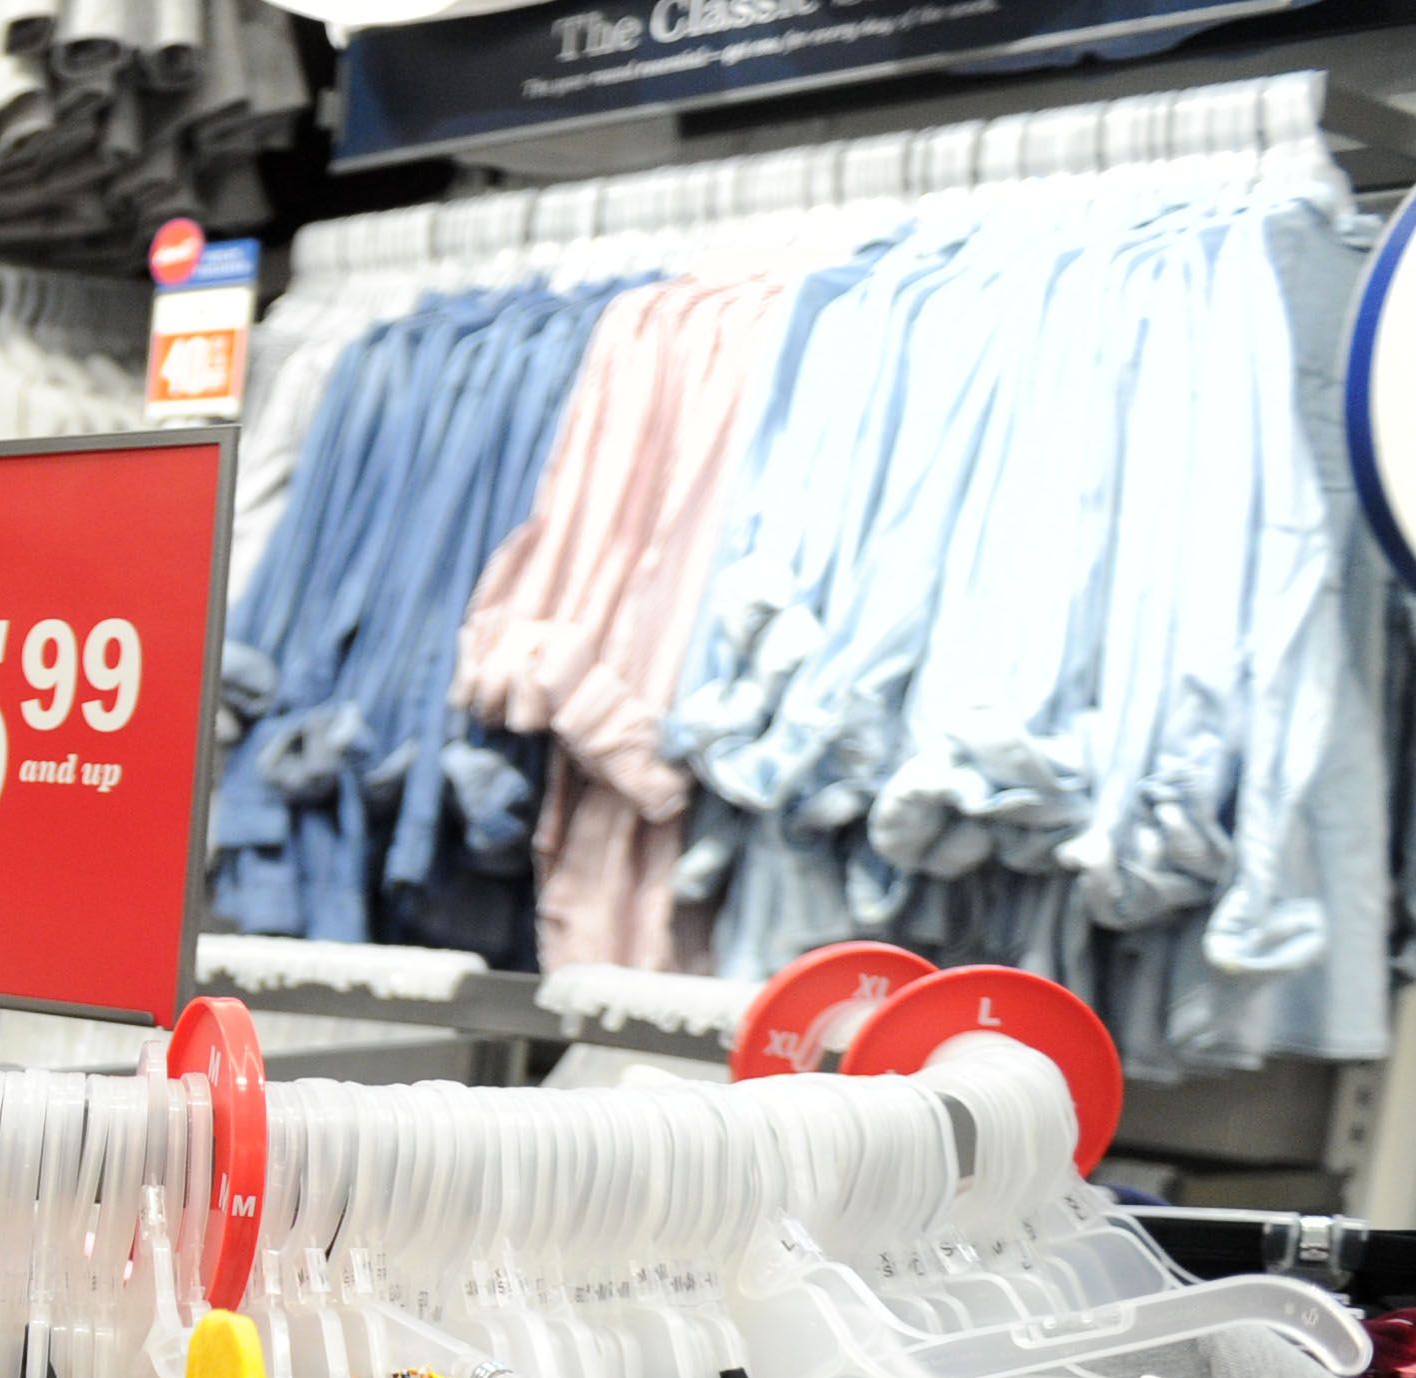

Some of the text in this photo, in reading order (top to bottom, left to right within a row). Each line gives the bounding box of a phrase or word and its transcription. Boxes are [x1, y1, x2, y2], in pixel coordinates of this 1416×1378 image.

[551, 11, 642, 62] The
[18, 754, 122, 793] and up
[978, 996, 1000, 1027] L
[231, 1195, 256, 1217] M
